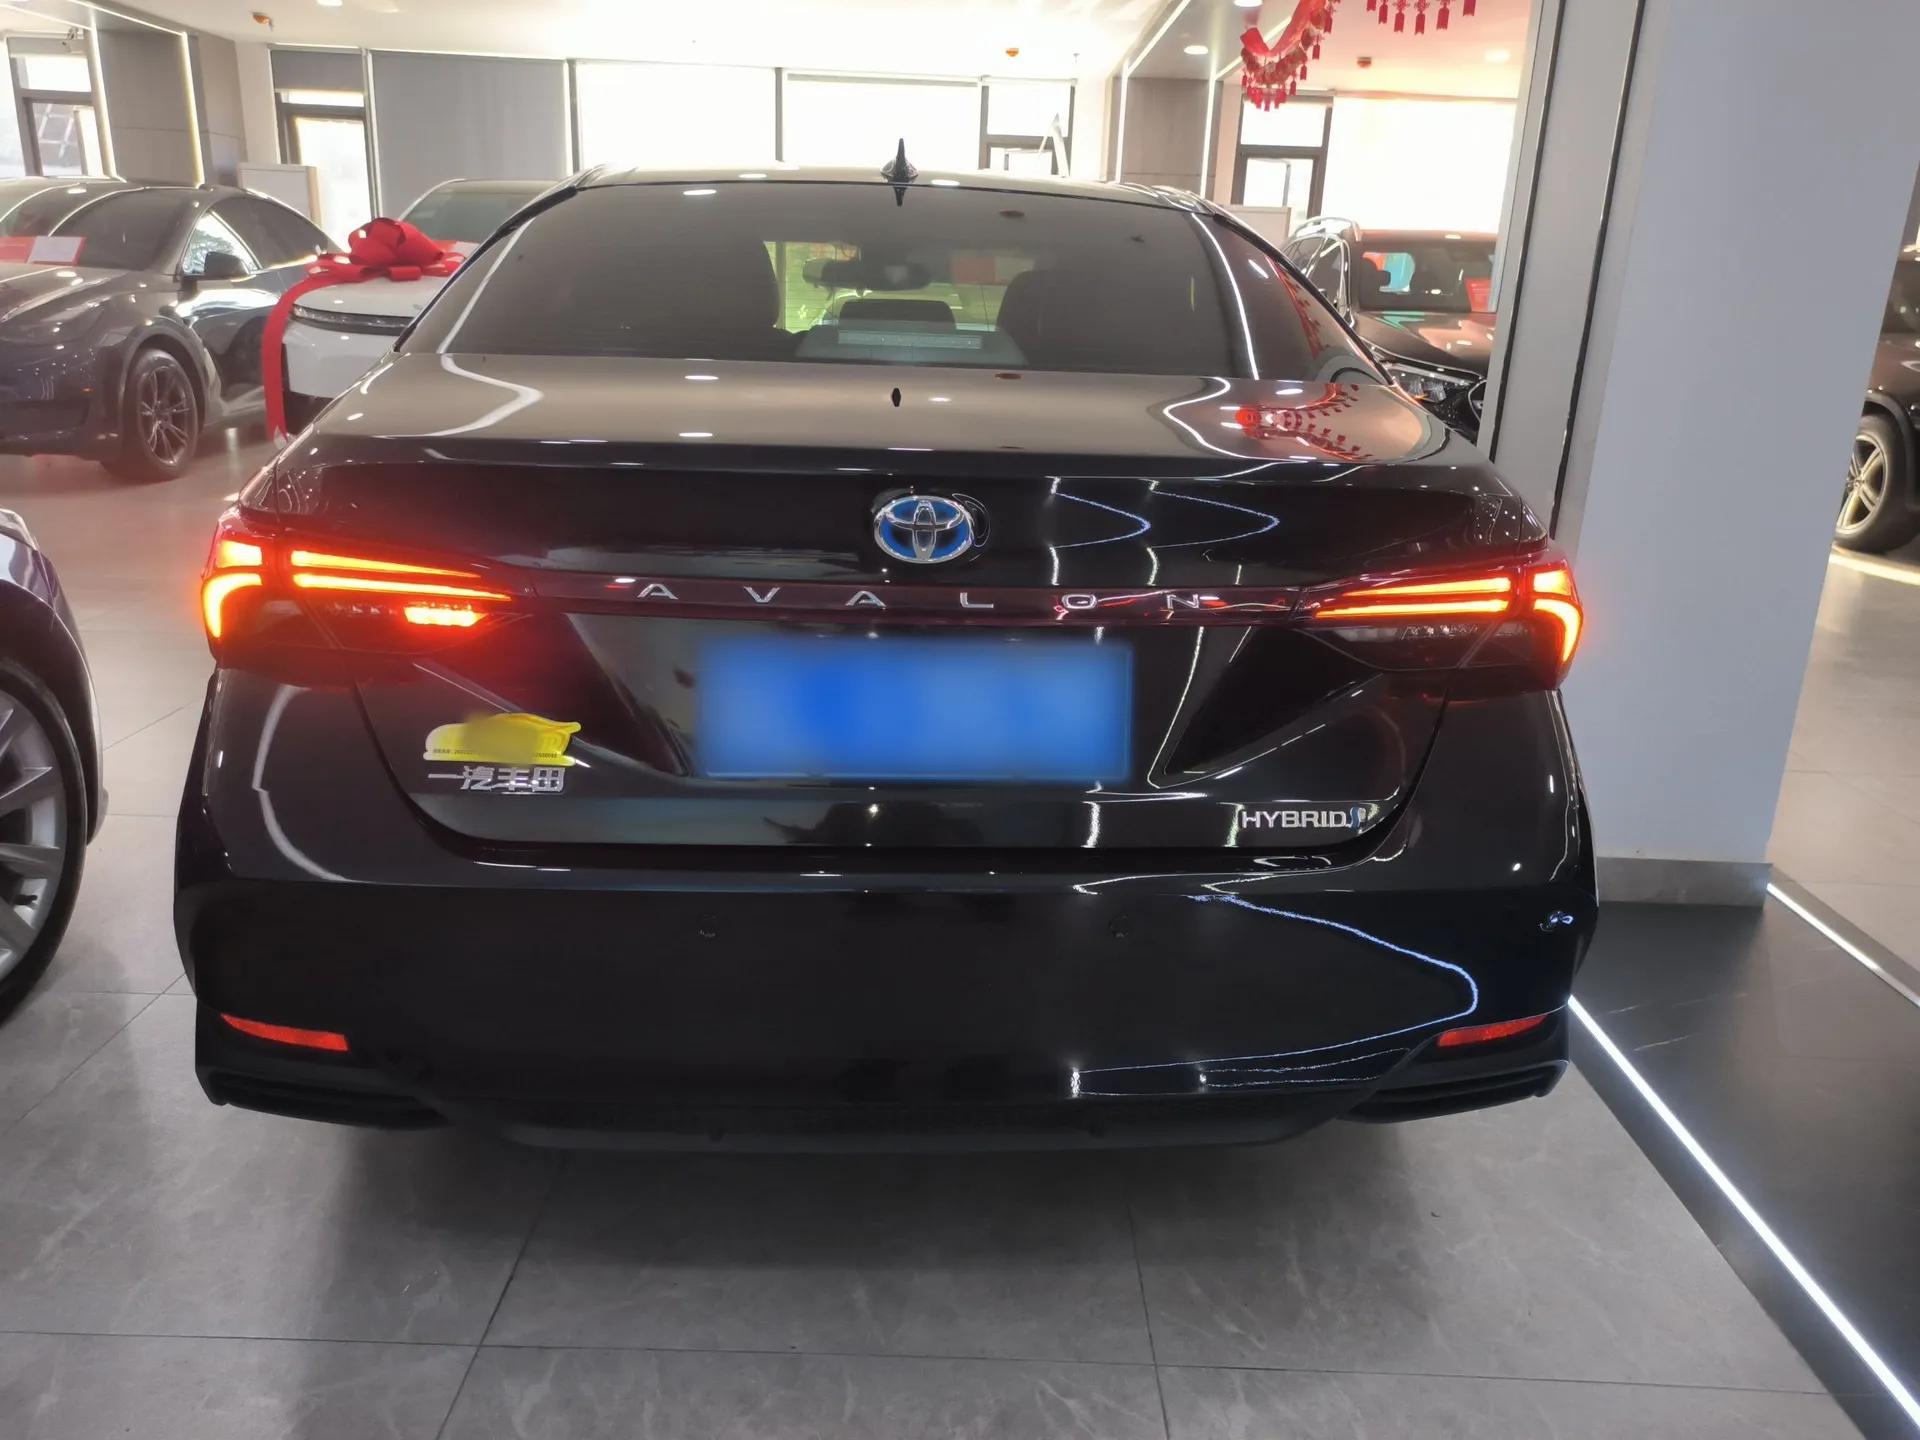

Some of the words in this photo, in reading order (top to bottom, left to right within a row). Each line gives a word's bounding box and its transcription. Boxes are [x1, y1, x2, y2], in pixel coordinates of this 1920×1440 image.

[637, 583, 1200, 611] AVALON
[427, 766, 566, 792] 一汽丰田
[1242, 810, 1347, 829] HYBRID
